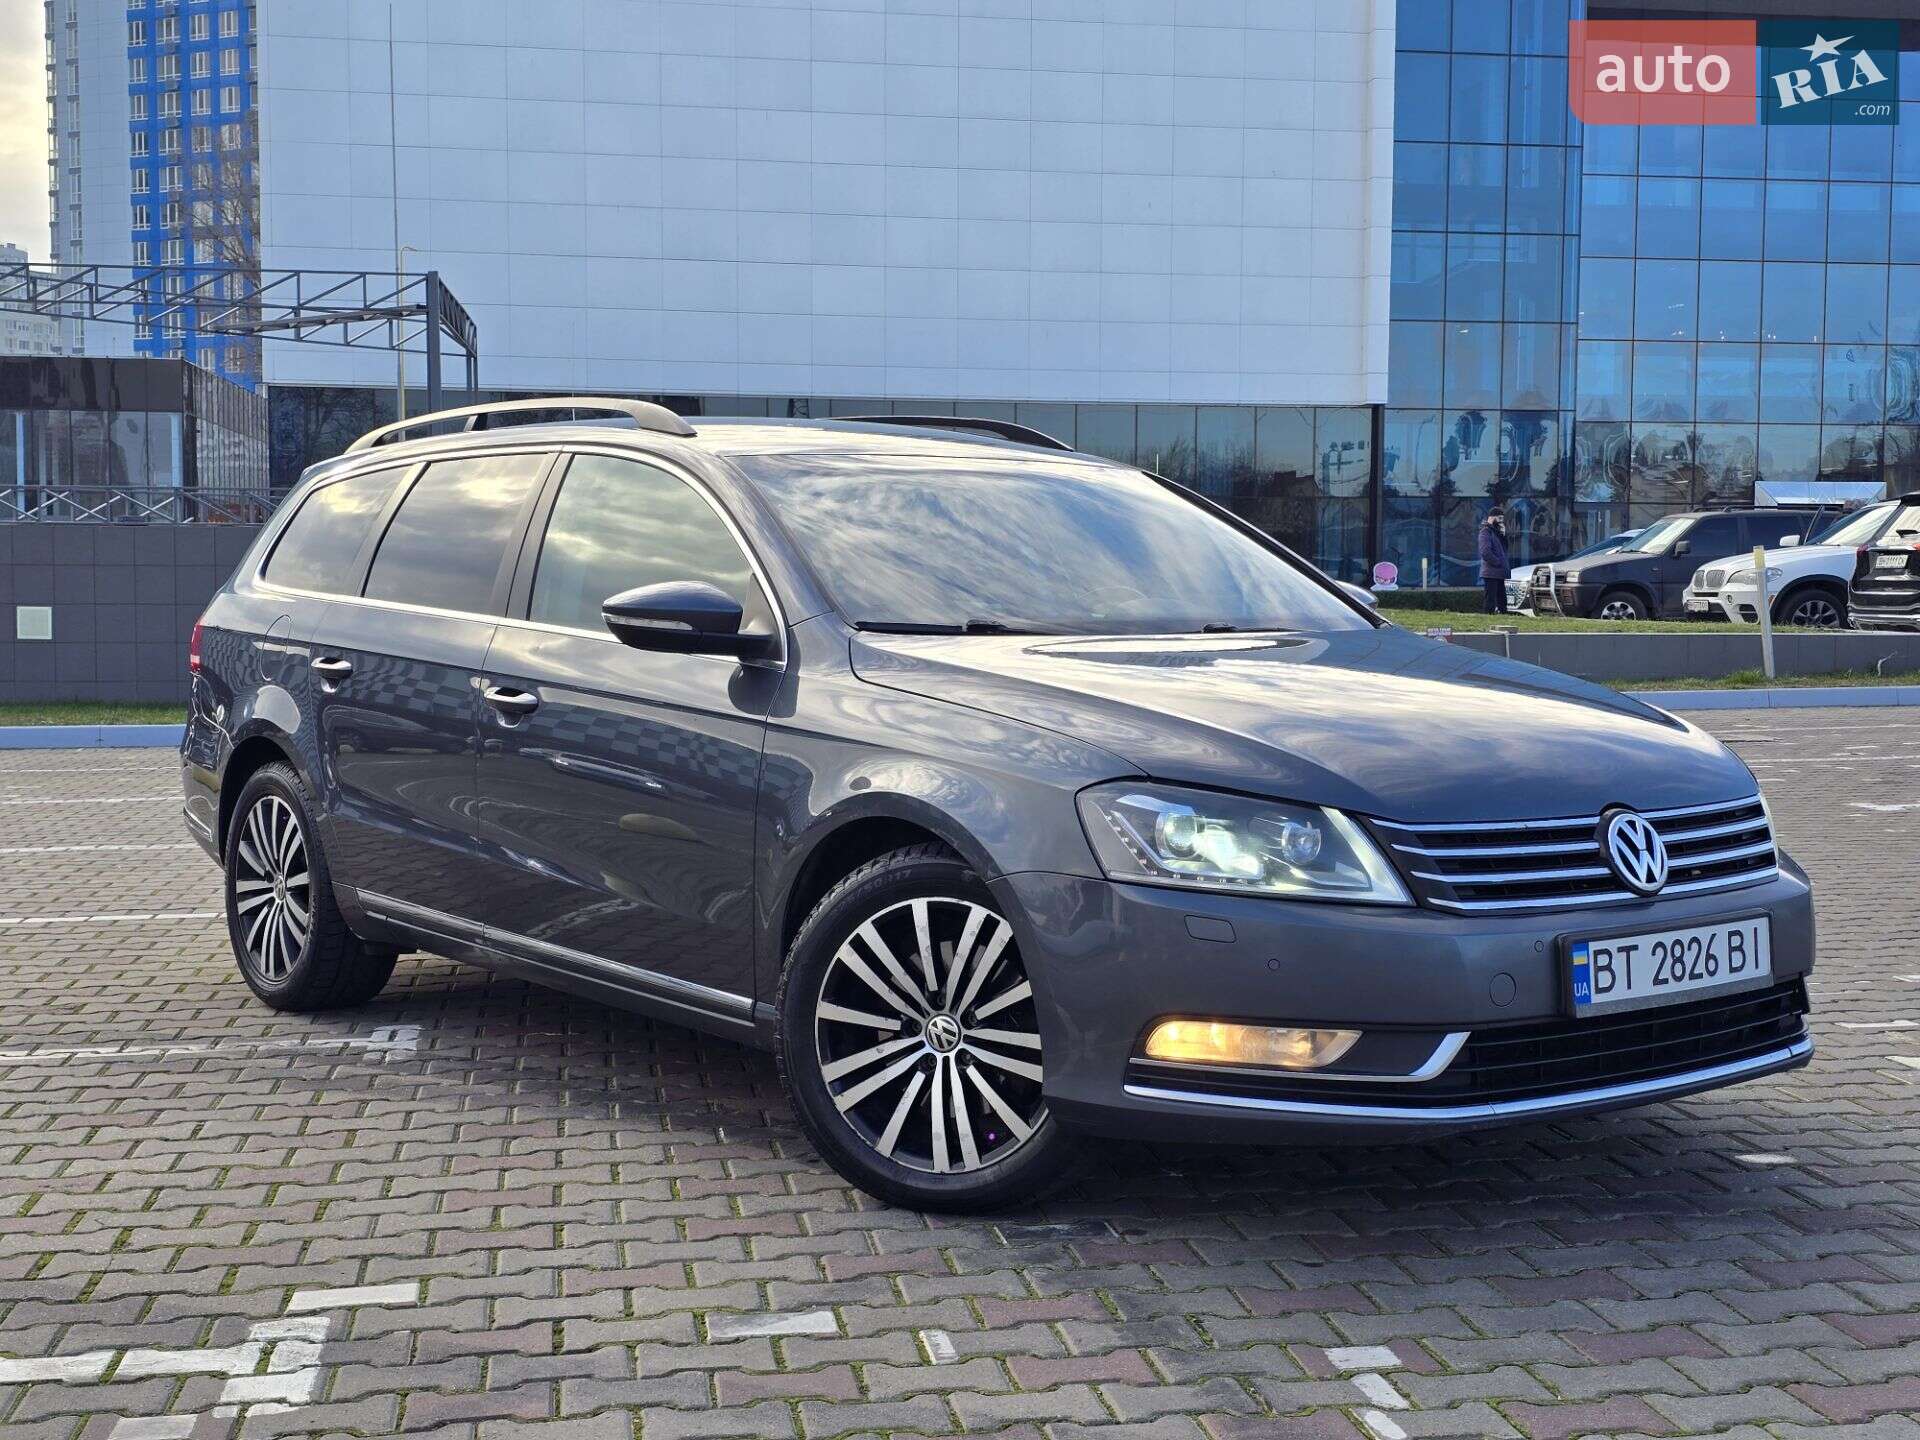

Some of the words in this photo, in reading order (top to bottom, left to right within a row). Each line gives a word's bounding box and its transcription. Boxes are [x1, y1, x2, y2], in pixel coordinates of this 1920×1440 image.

[1593, 944, 1639, 995] BT
[1650, 932, 1719, 987] 2826
[1727, 926, 1760, 975] BI
[1573, 981, 1590, 996] UA
